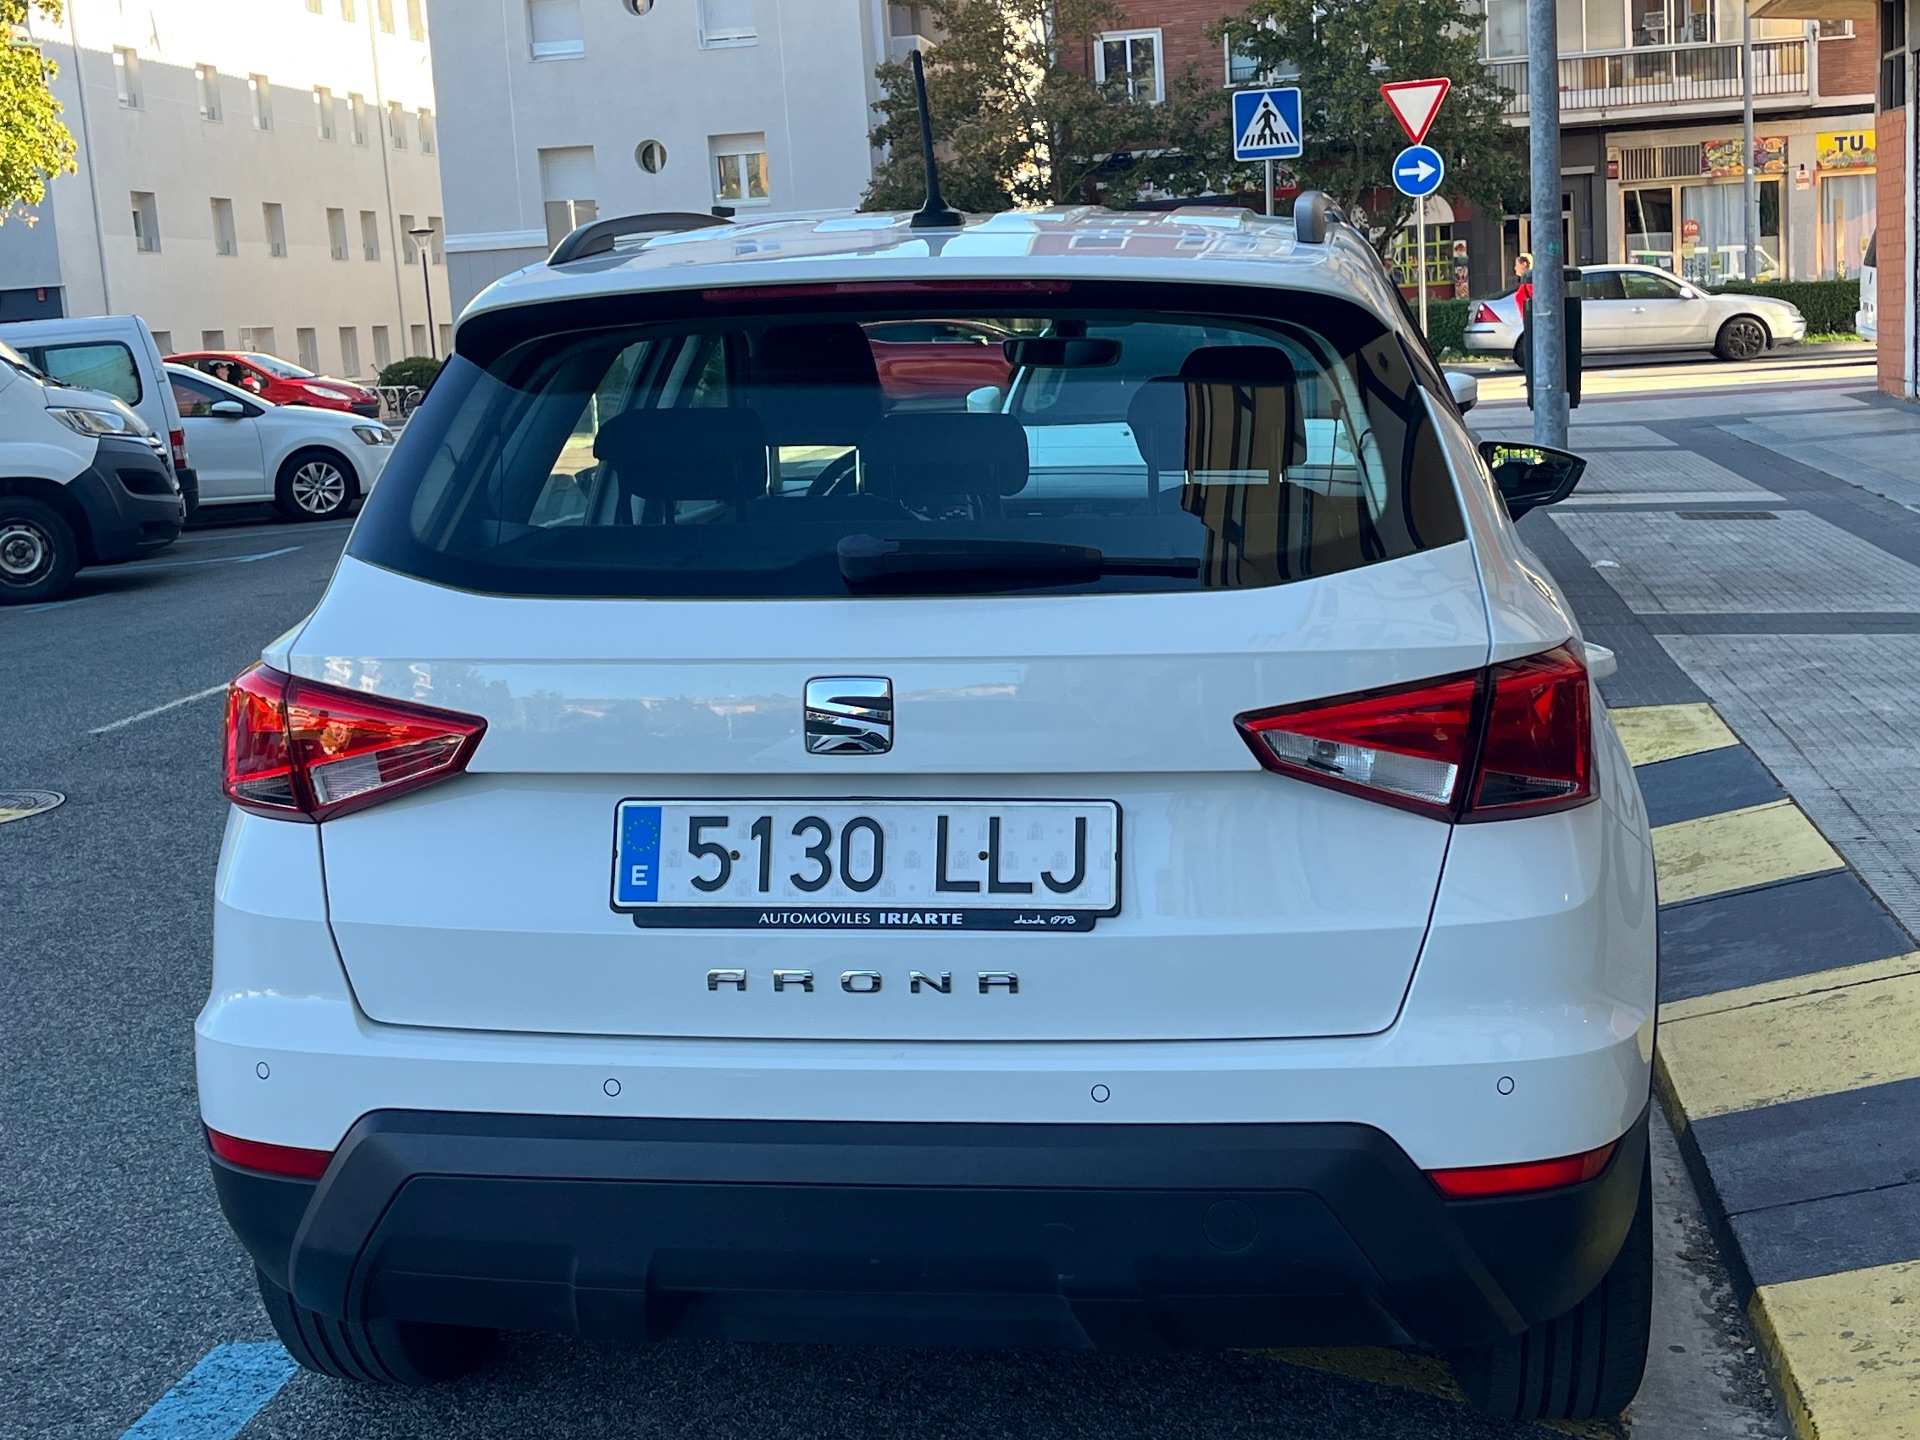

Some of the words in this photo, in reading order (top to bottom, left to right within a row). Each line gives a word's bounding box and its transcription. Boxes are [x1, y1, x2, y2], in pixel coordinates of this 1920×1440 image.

[1834, 134, 1864, 153] TU
[688, 816, 884, 892] 5130
[935, 815, 1097, 893] LLJ
[631, 865, 649, 885] E
[758, 911, 871, 925] AUTOMÓVILES
[879, 912, 963, 925] IRIARTE
[1050, 915, 1076, 925] 1978
[707, 968, 1019, 994] ARONA
